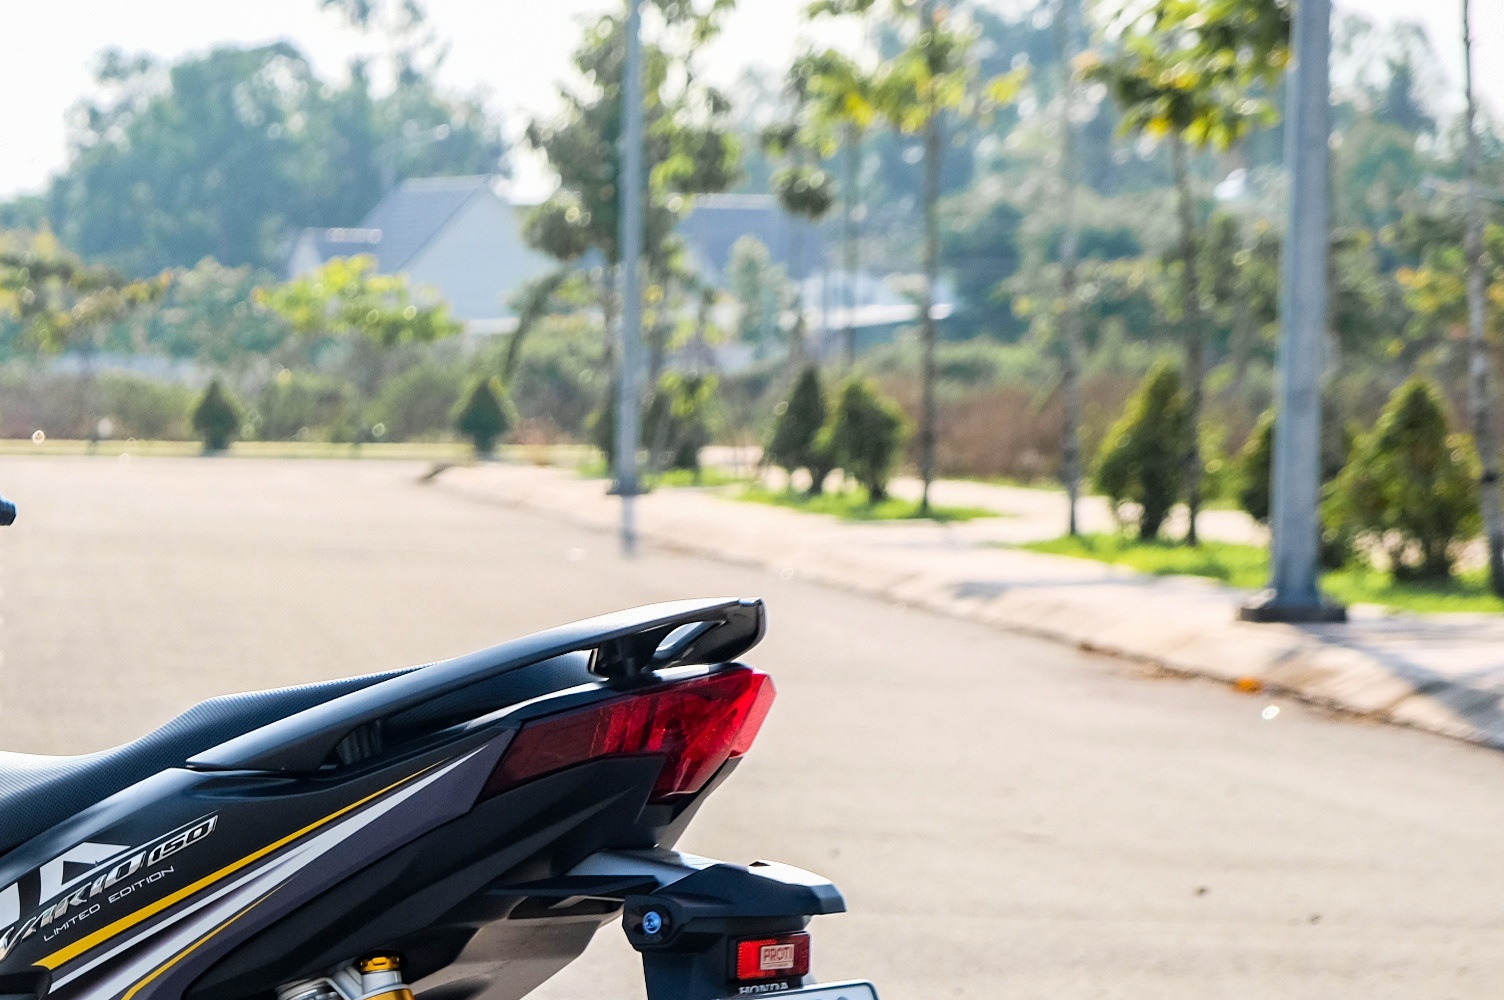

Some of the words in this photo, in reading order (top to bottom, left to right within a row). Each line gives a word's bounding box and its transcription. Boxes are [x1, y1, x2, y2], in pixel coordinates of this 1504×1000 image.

[147, 814, 219, 867] 150
[43, 904, 101, 942] LIMITED
[108, 865, 175, 903] EDITION
[763, 946, 793, 961] PROTI
[738, 982, 788, 994] HONDA
